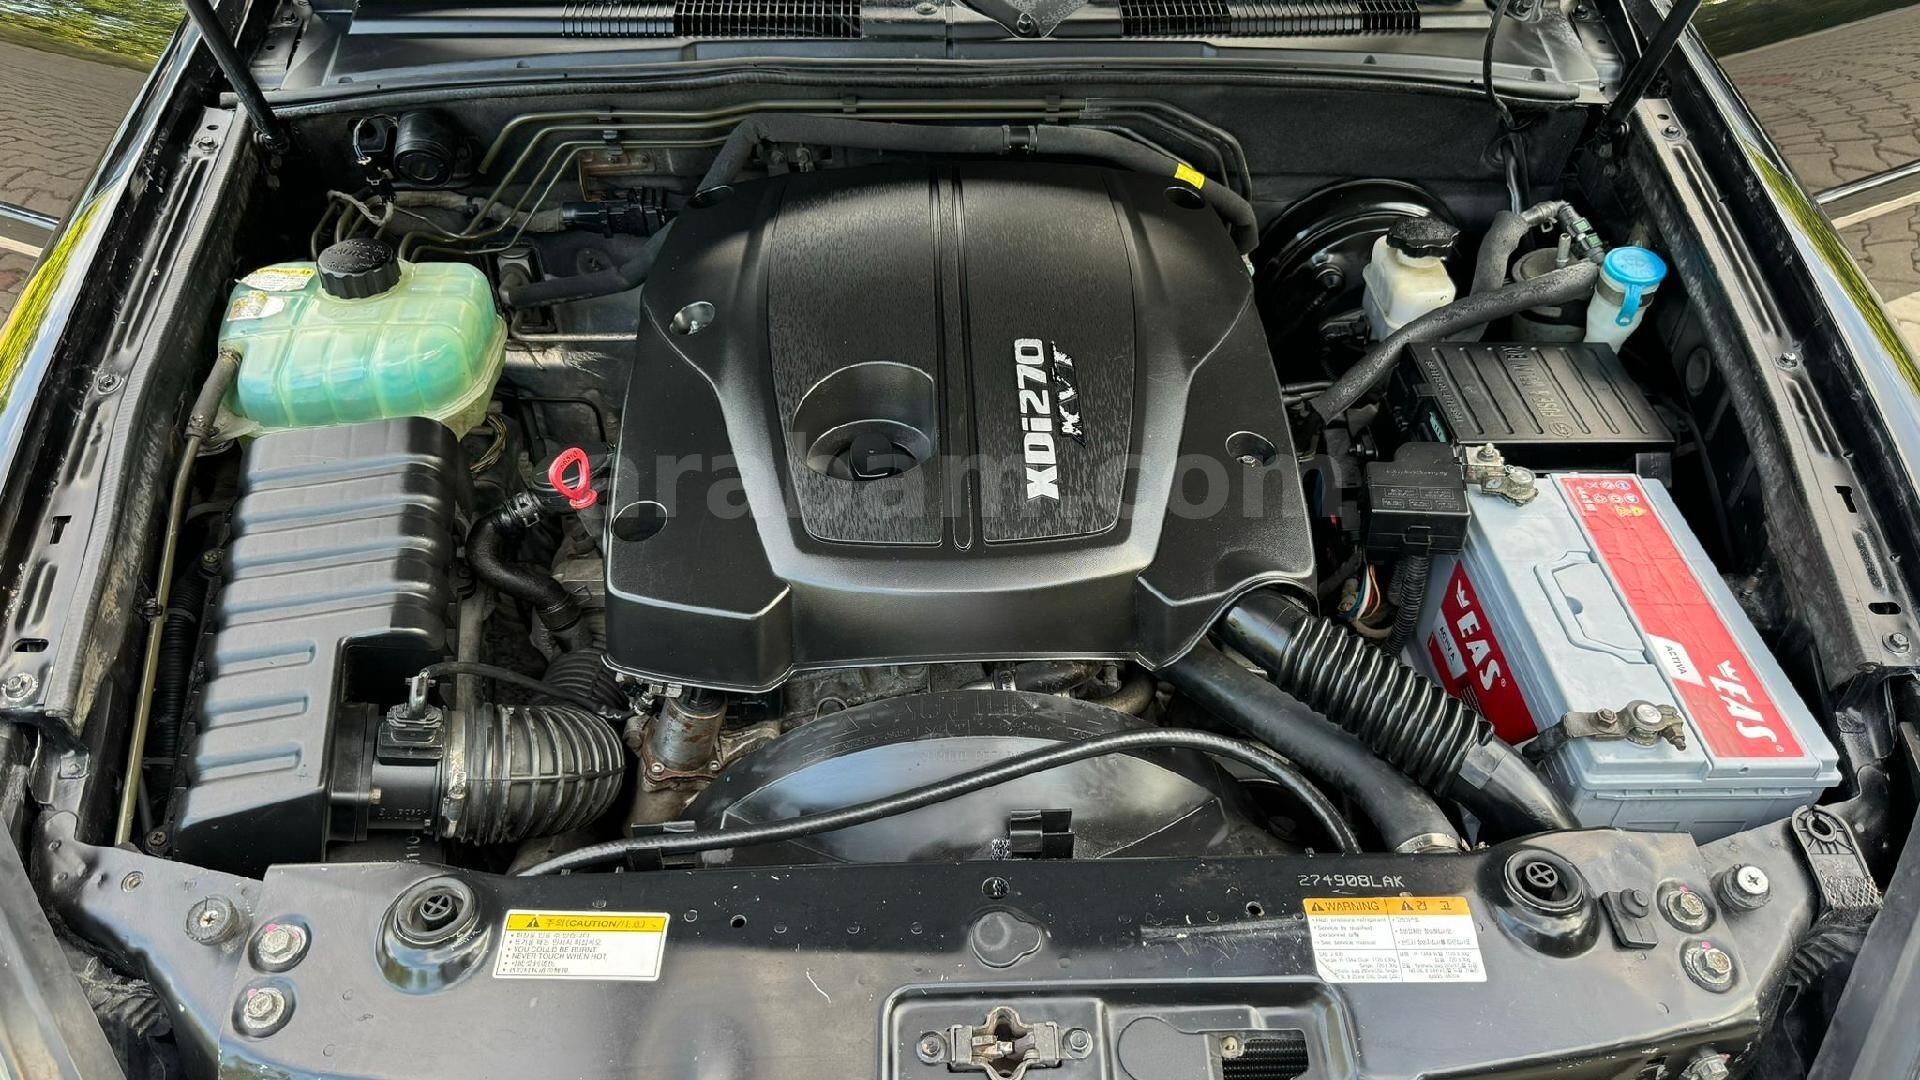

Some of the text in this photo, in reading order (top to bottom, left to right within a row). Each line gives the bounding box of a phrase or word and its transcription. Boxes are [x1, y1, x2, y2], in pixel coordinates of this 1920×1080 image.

[1014, 338, 1059, 500] XDi270
[1663, 645, 1689, 677] ACTIVA
[1297, 874, 1406, 888] 274908LAK
[1324, 902, 1380, 911] WARNING
